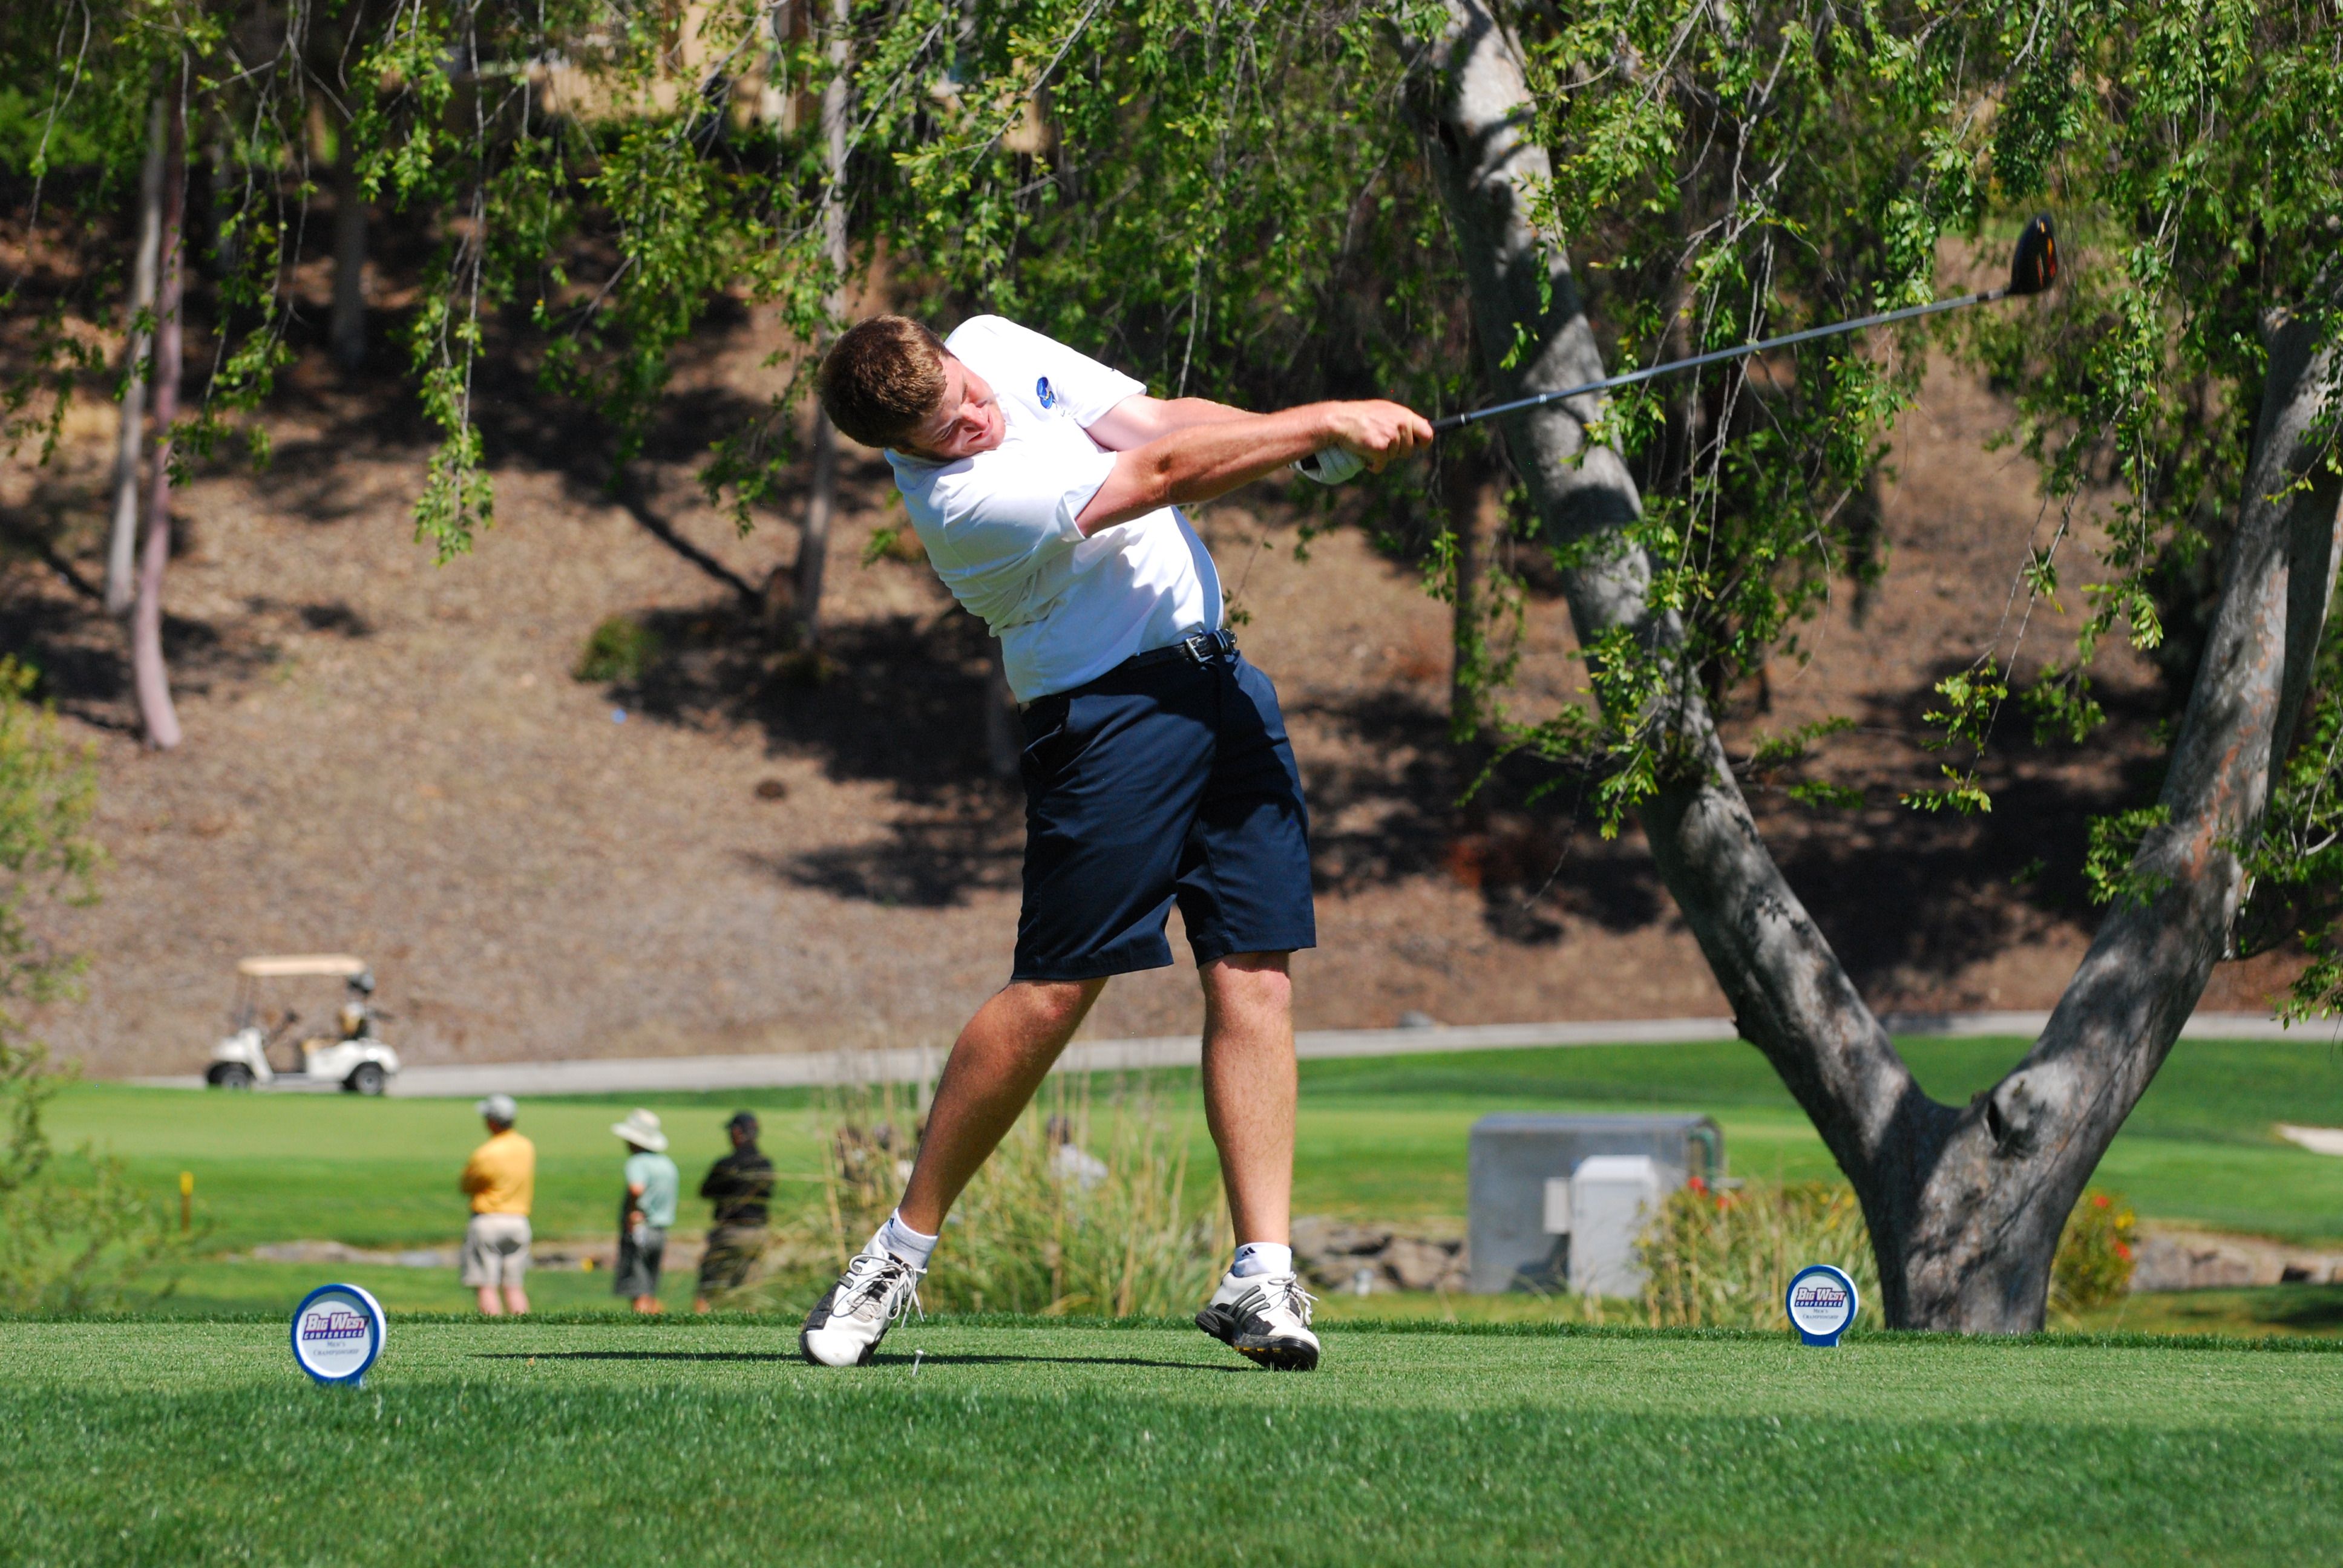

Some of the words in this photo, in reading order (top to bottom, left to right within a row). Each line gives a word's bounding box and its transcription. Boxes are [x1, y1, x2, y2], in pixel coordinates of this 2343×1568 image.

[1797, 1288, 1816, 1301] BIG
[1816, 1288, 1846, 1301] WEST
[305, 1314, 330, 1331] BIG
[330, 1313, 367, 1330] WEST
[303, 1331, 364, 1339] CONFERENCE
